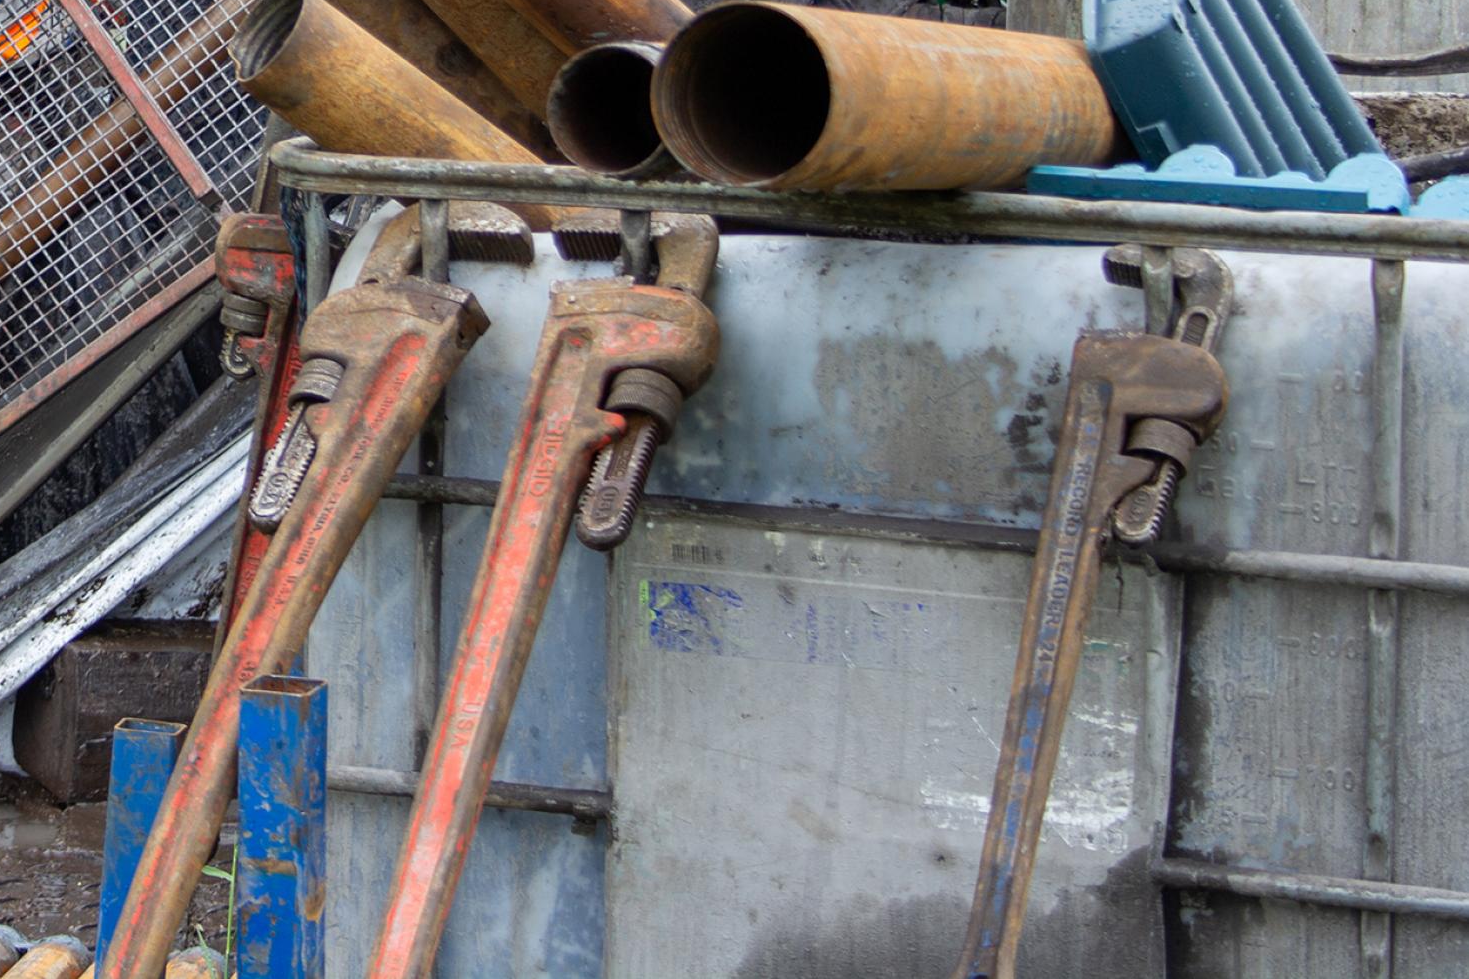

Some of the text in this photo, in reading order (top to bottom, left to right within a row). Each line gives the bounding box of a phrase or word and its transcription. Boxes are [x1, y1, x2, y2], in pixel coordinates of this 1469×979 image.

[1038, 462, 1092, 663] RECORD LEADER 24
[451, 702, 483, 748] USA
